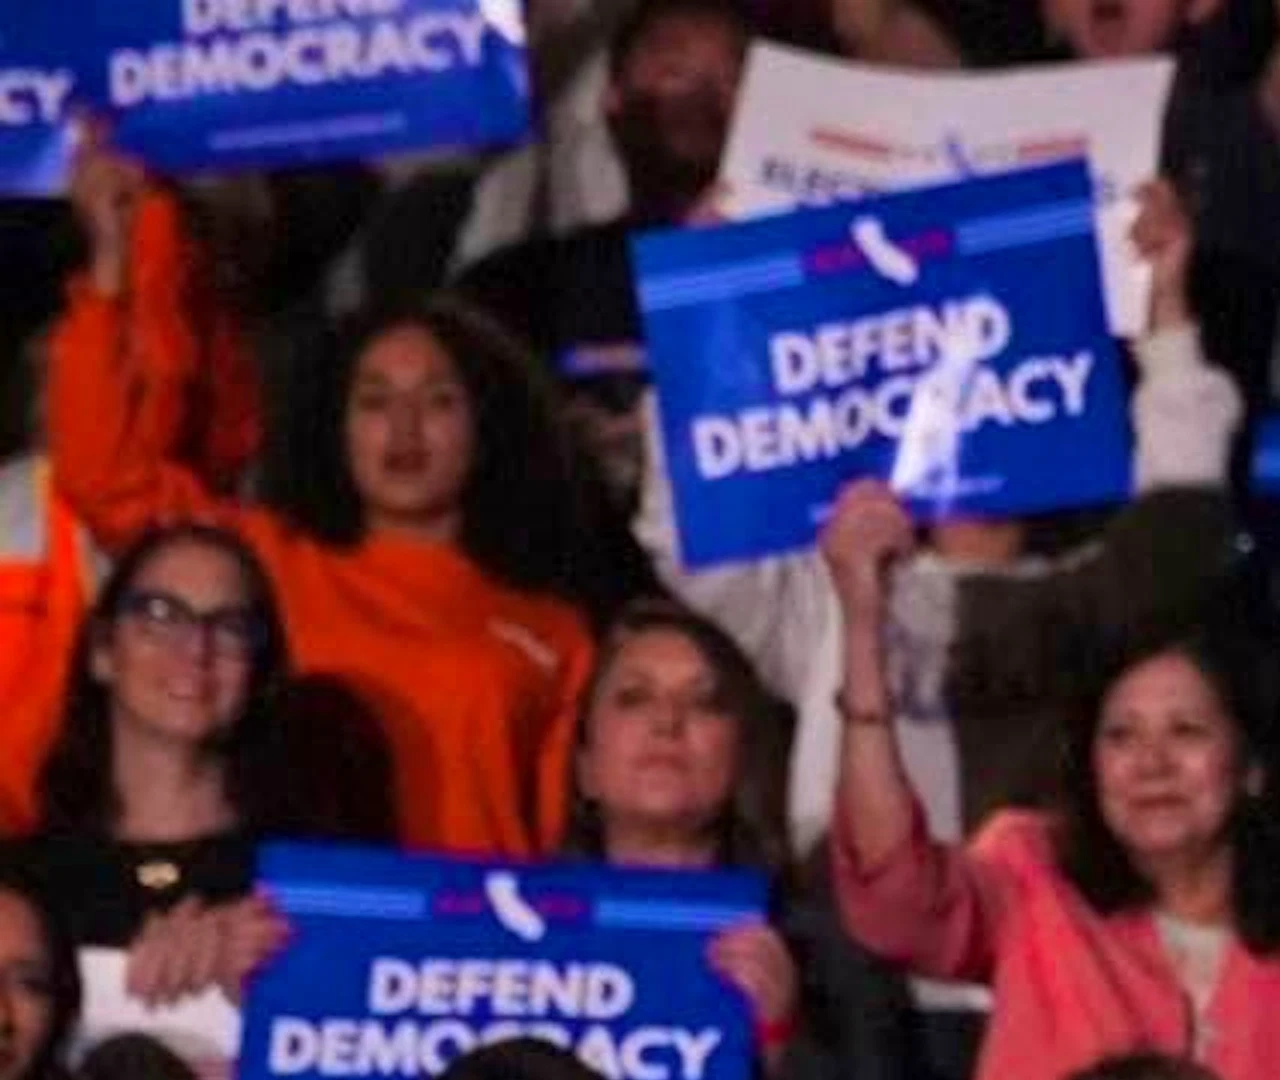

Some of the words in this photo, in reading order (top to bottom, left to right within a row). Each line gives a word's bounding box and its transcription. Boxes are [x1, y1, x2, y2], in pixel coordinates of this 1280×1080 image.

[107, 12, 484, 106] DEMOCRACY
[768, 293, 1011, 395] DEFEND
[368, 958, 636, 1019] DEFEND
